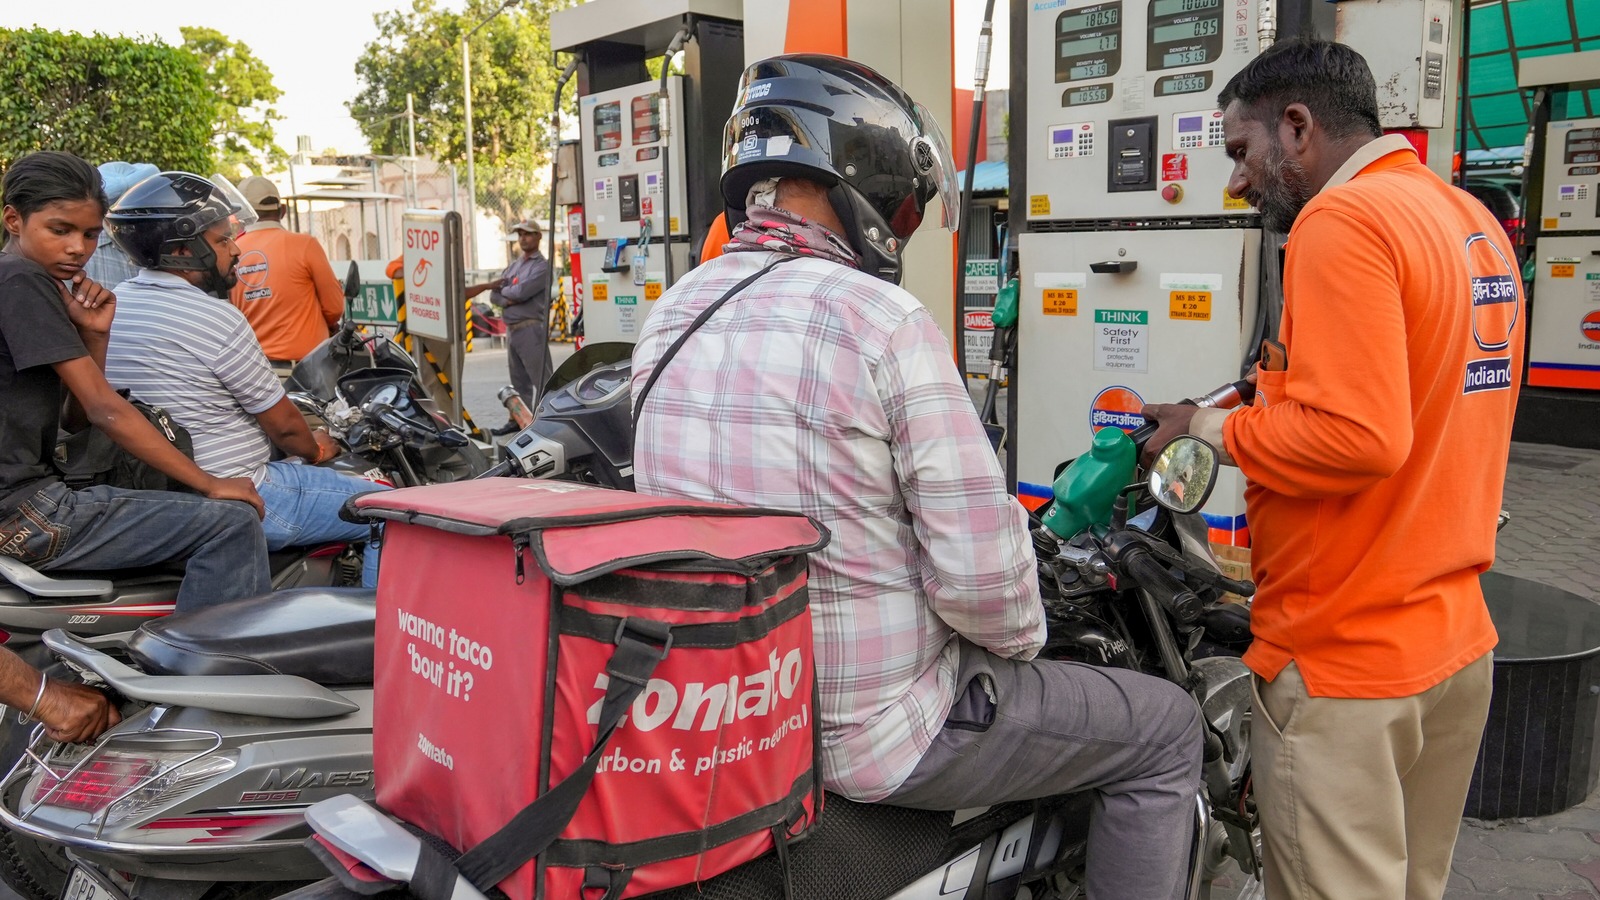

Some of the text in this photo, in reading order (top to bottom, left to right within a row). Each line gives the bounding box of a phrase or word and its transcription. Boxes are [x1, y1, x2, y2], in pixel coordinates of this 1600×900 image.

[1086, 10, 1116, 26] 180.50
[1194, 20, 1216, 36] 0.95
[1180, 50, 1204, 63] 751.9
[1085, 65, 1106, 76] 751.9
[1173, 78, 1203, 91] 105.56
[1080, 90, 1106, 101] 105.56
[742, 116, 754, 128] 900
[407, 228, 439, 251] STOP
[965, 263, 998, 276] CAREF
[412, 306, 440, 320] PROGRESS
[1101, 312, 1141, 322] THINK
[1103, 328, 1139, 338] Safety
[1093, 410, 1145, 426] इंडियनऑयल
[398, 608, 492, 670] wanna taco
[447, 662, 474, 702] it?
[583, 704, 808, 776] rbon & plastic neutral
[417, 733, 454, 770] zomato
[240, 791, 300, 802] EDGE
